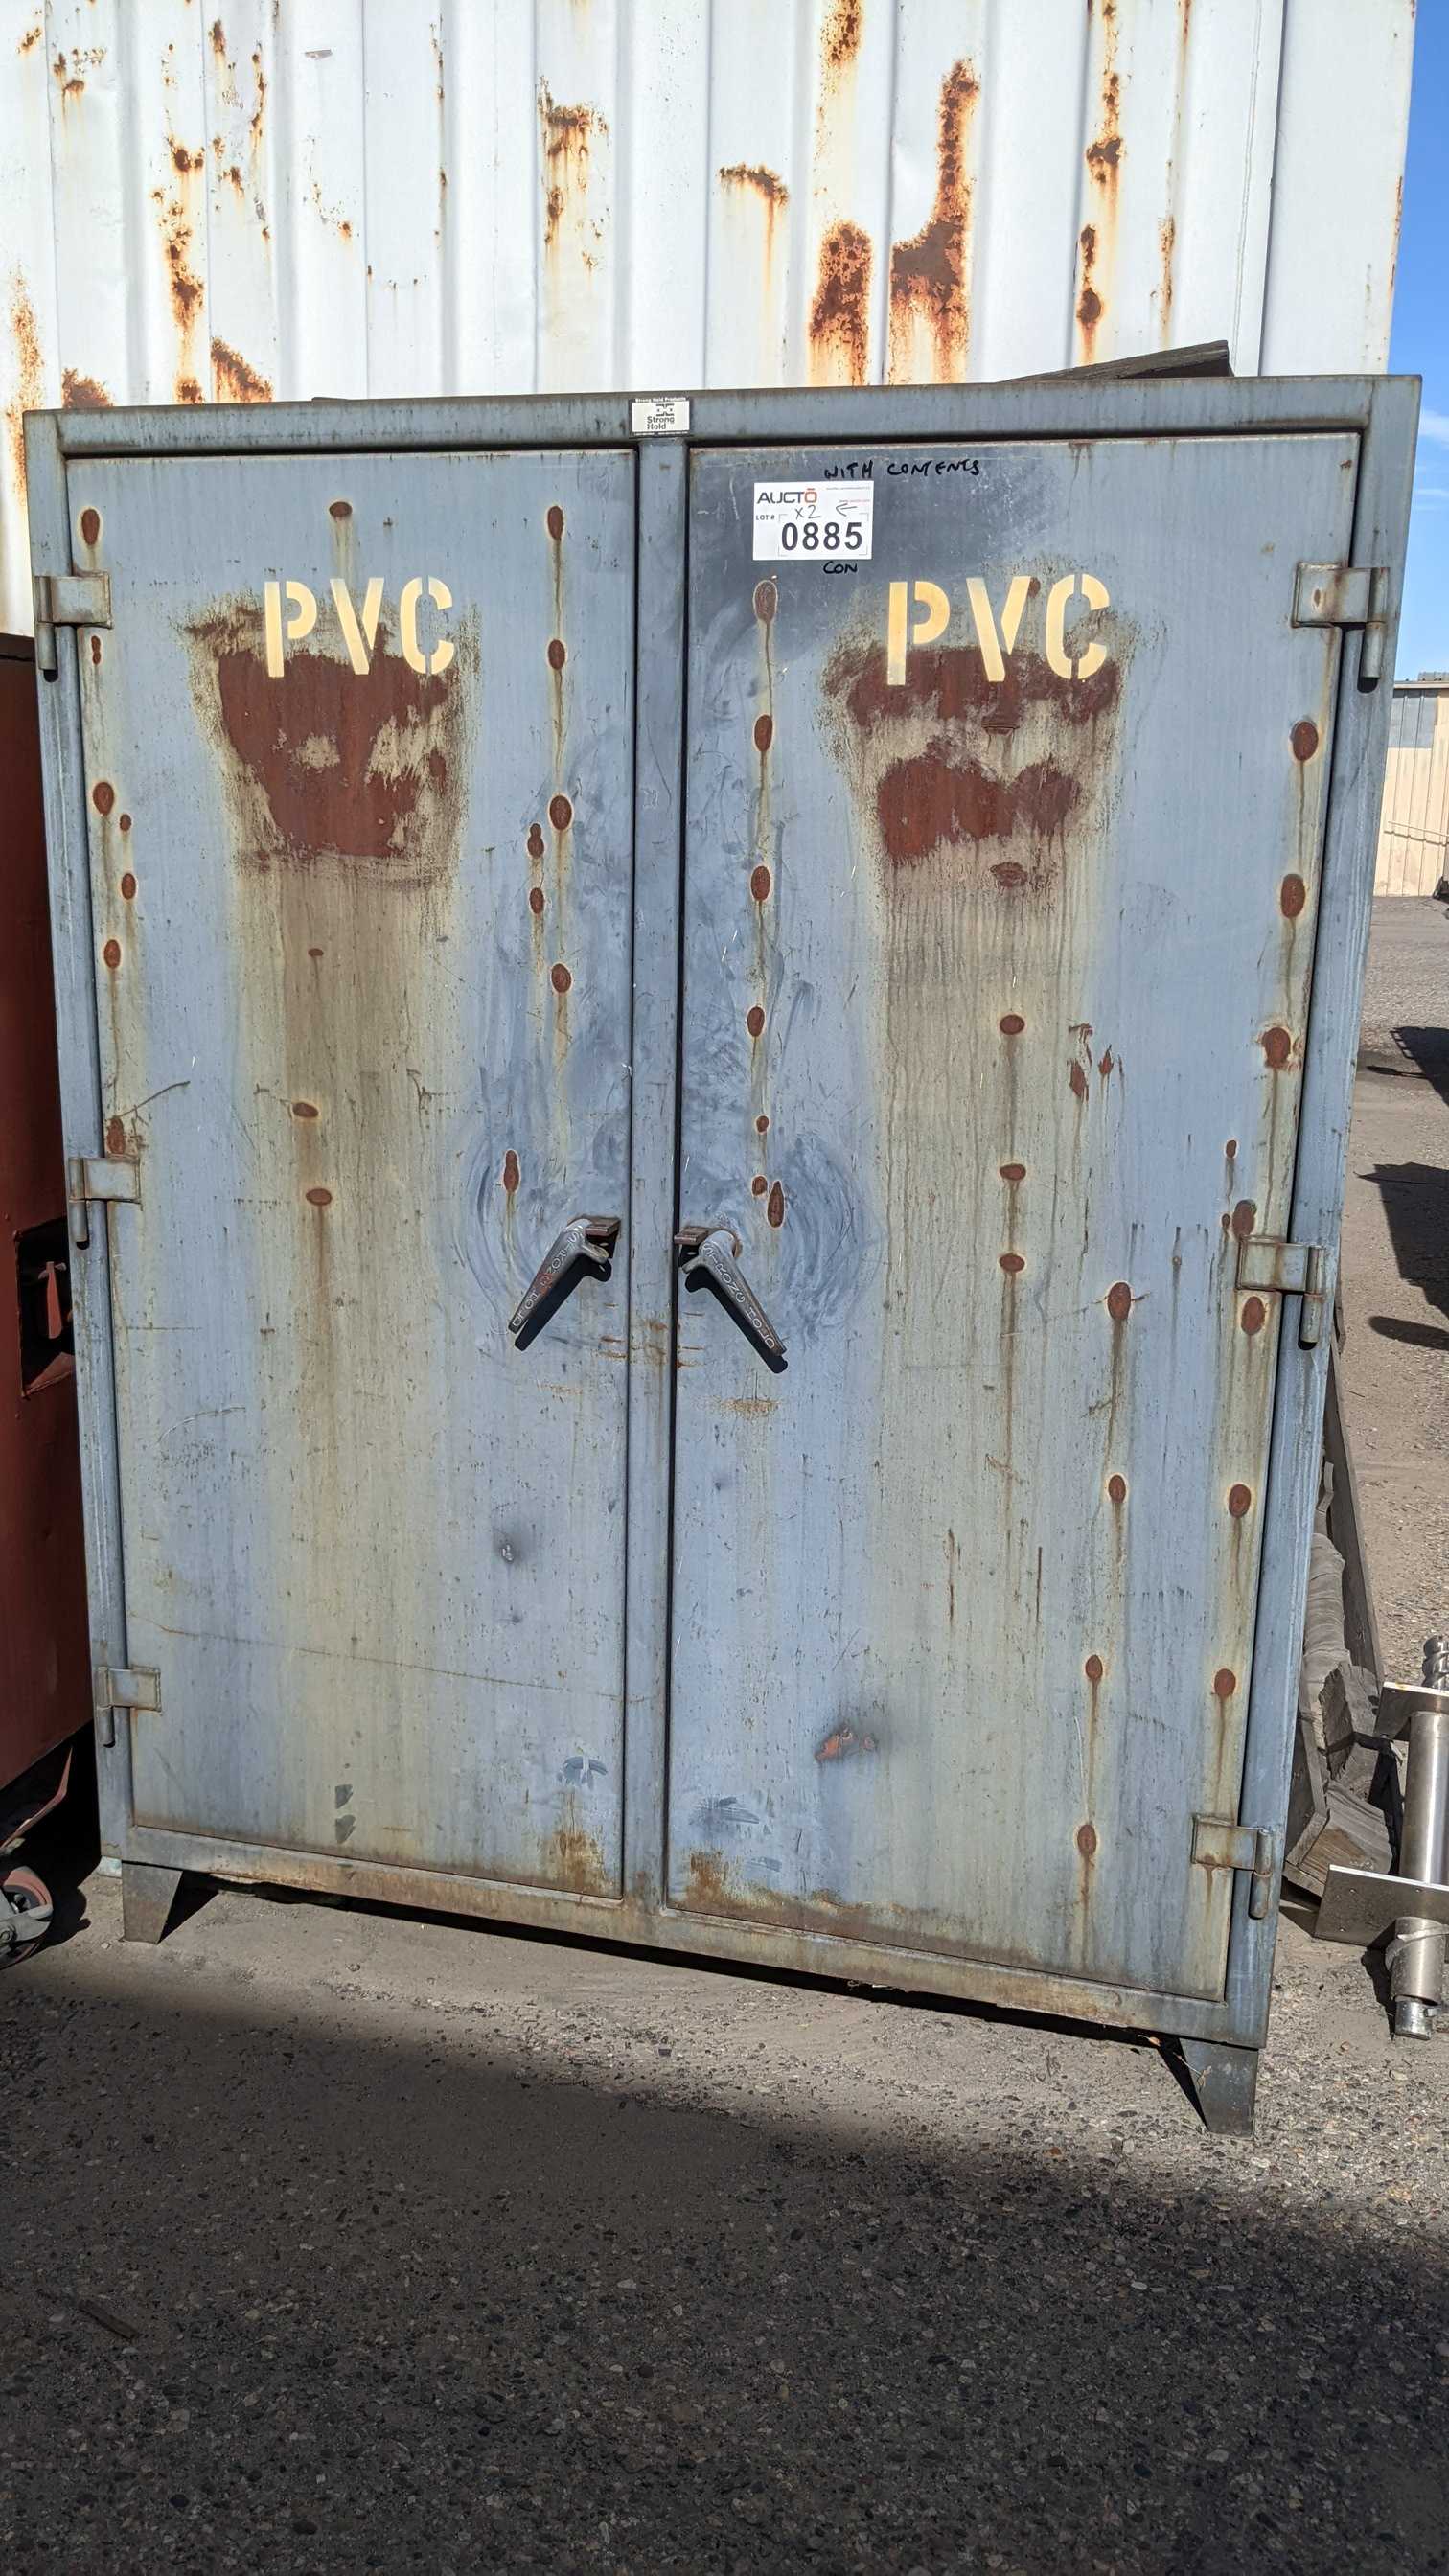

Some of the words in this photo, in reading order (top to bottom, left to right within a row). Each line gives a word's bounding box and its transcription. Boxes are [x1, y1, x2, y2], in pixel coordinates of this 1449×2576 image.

[647, 416, 675, 425] Strong
[824, 459, 873, 479] WITH
[887, 458, 979, 476] CONTENTS
[781, 522, 862, 551] 0885
[823, 561, 858, 574] CON
[264, 577, 455, 678] PVC
[887, 573, 1110, 686] PVC
[702, 1242, 746, 1303] STRONG
[746, 1306, 775, 1349] HOLD
